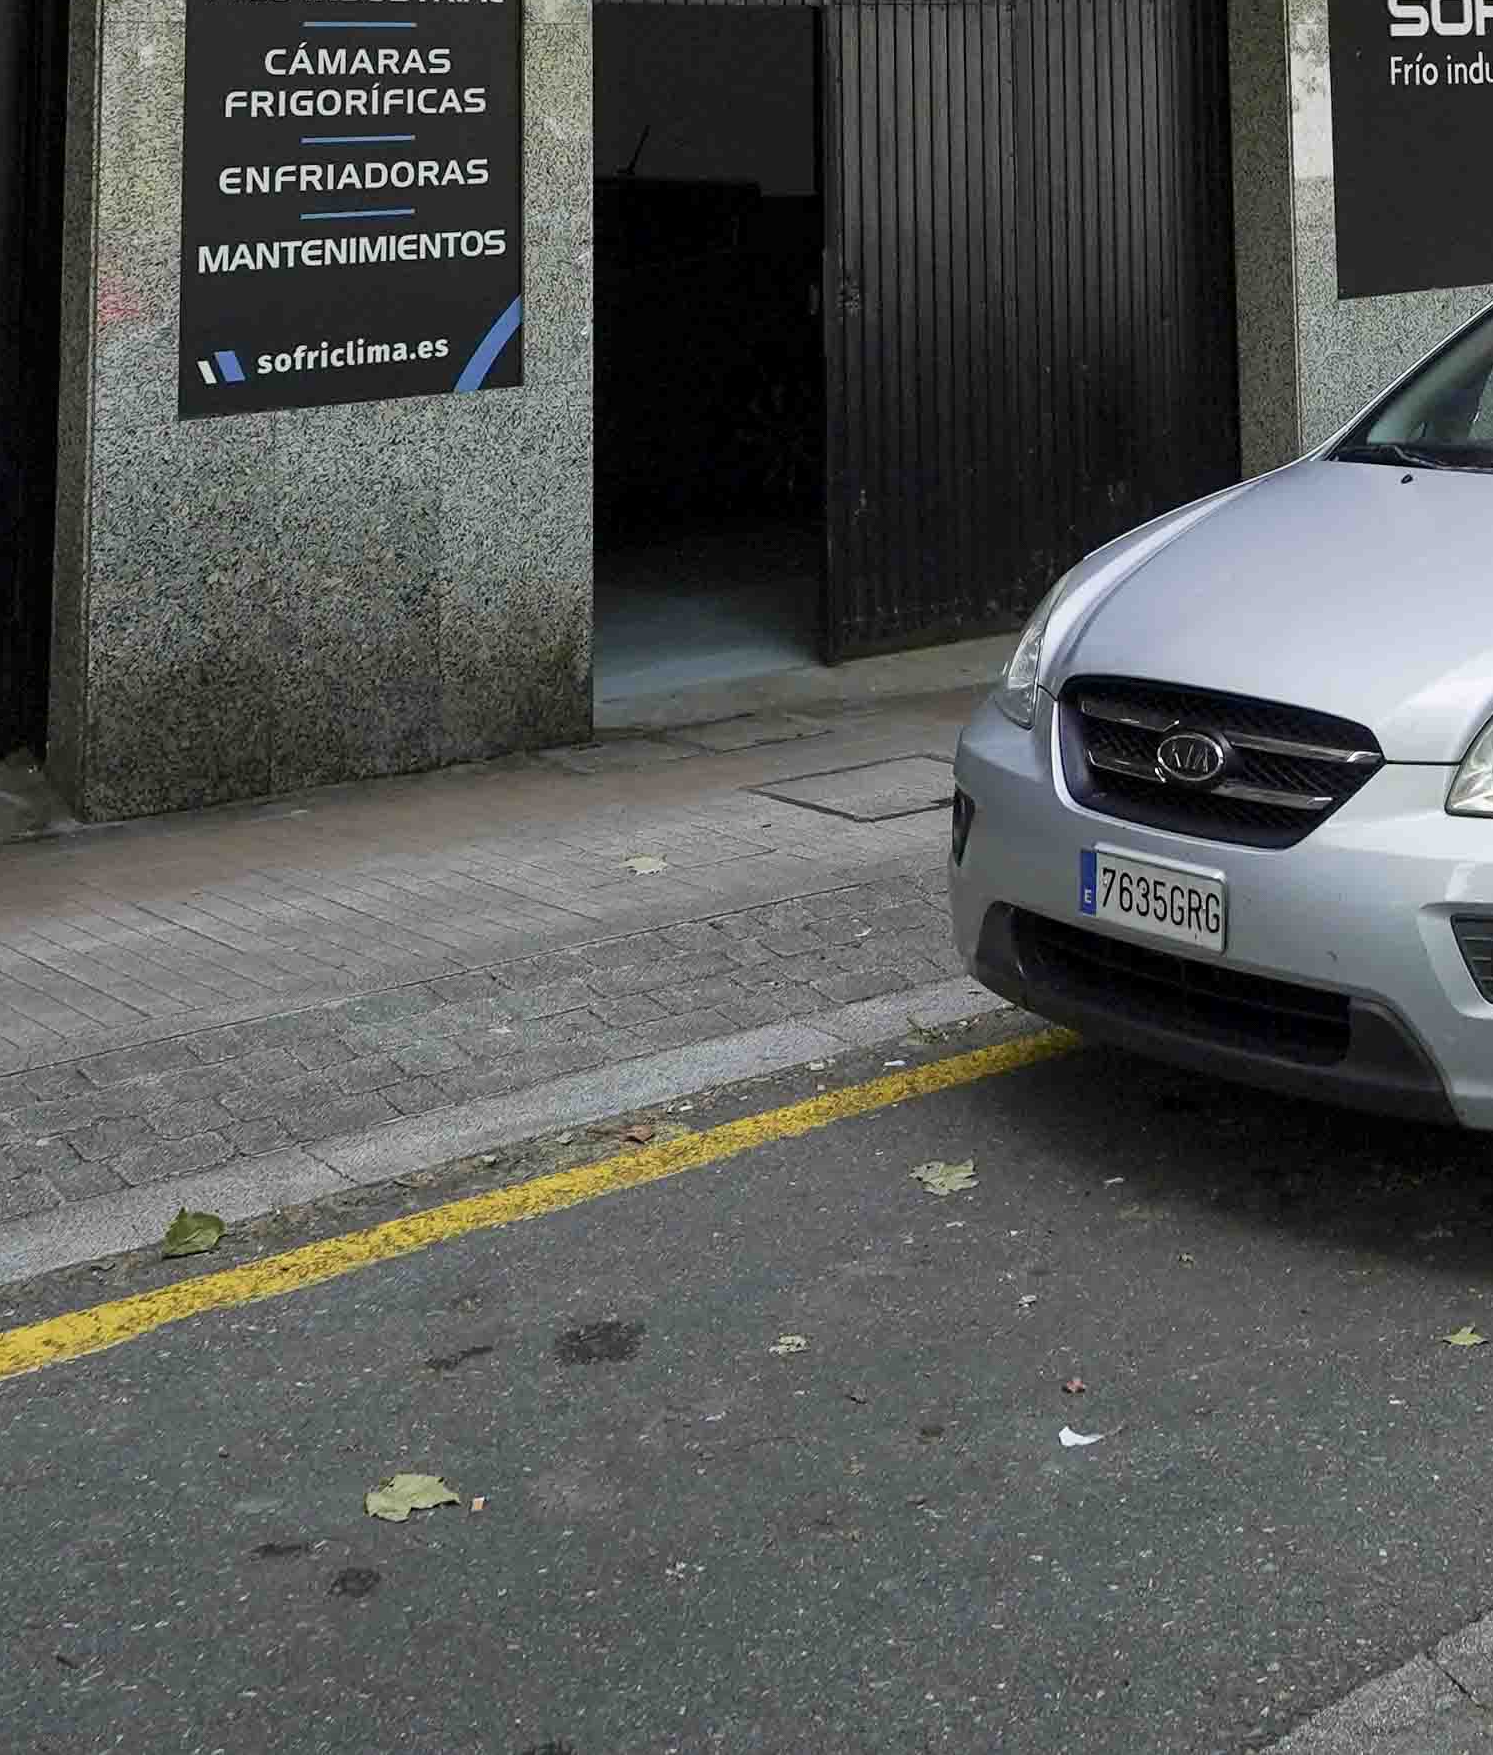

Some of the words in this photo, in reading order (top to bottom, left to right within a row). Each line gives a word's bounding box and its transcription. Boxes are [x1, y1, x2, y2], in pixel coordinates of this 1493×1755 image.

[264, 41, 451, 76] CÁMARAS
[1390, 52, 1439, 86] Frío
[225, 82, 487, 118] FRIGORÍFICAS
[219, 158, 489, 195] ENFRIADORAS
[198, 229, 506, 274] MANTENIMIENTOS
[257, 338, 449, 374] sofriclima.es
[1084, 888, 1092, 904] E
[1102, 866, 1220, 934] 7635GRG
